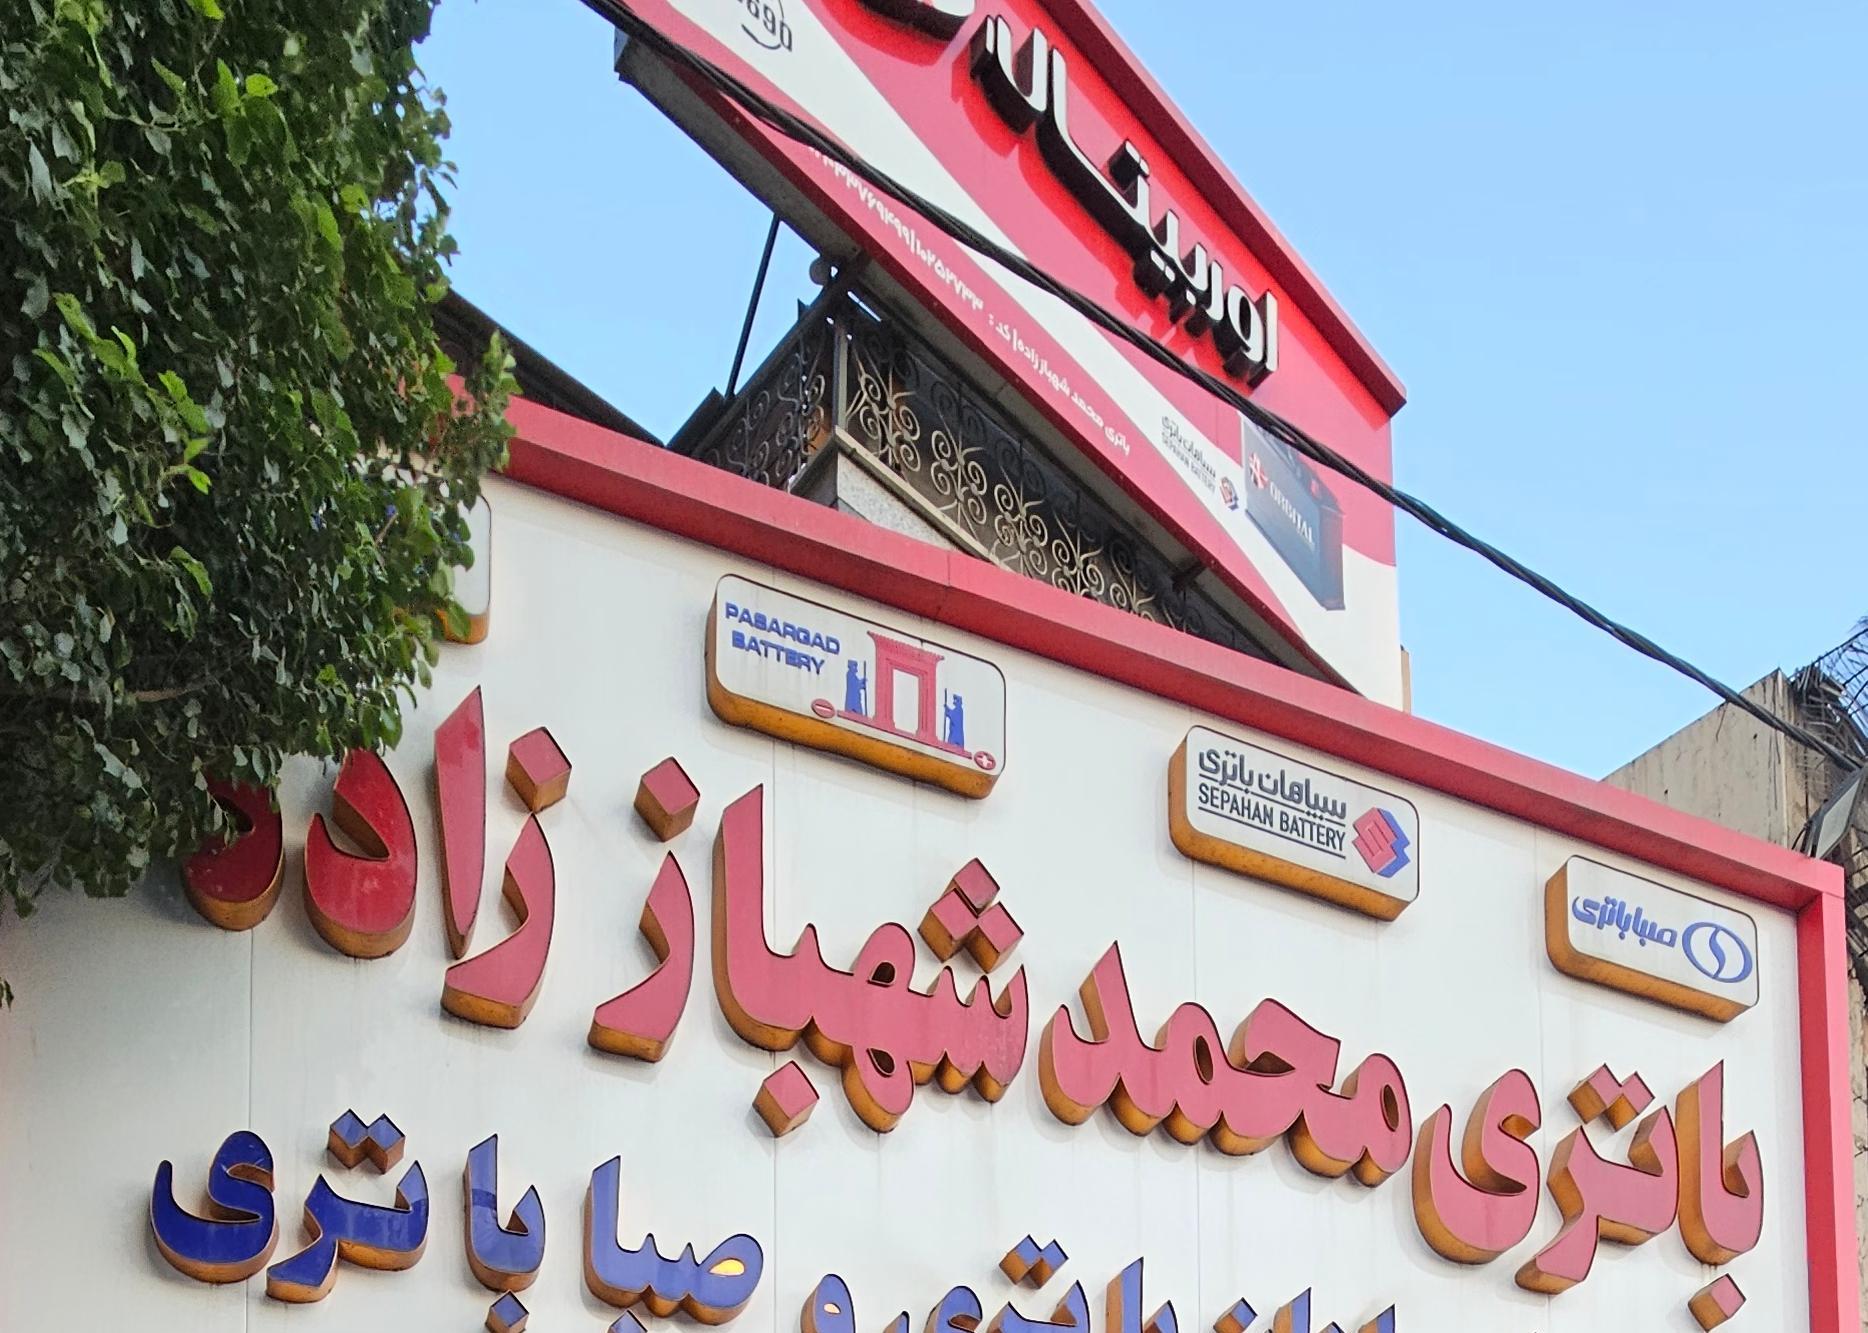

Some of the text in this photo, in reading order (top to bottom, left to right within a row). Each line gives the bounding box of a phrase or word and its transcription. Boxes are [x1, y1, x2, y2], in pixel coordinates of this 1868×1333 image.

[1071, 391, 1105, 428] محمد
[1104, 426, 1131, 457] باتری
[725, 602, 841, 656] PASARGAD
[731, 630, 825, 676] BATTERY
[1198, 748, 1347, 822] سپاهان باتری
[1198, 781, 1347, 852] SEPAHAN BATTERY
[1037, 938, 1413, 1188] محمد
[1413, 1058, 1764, 1332] باتری
